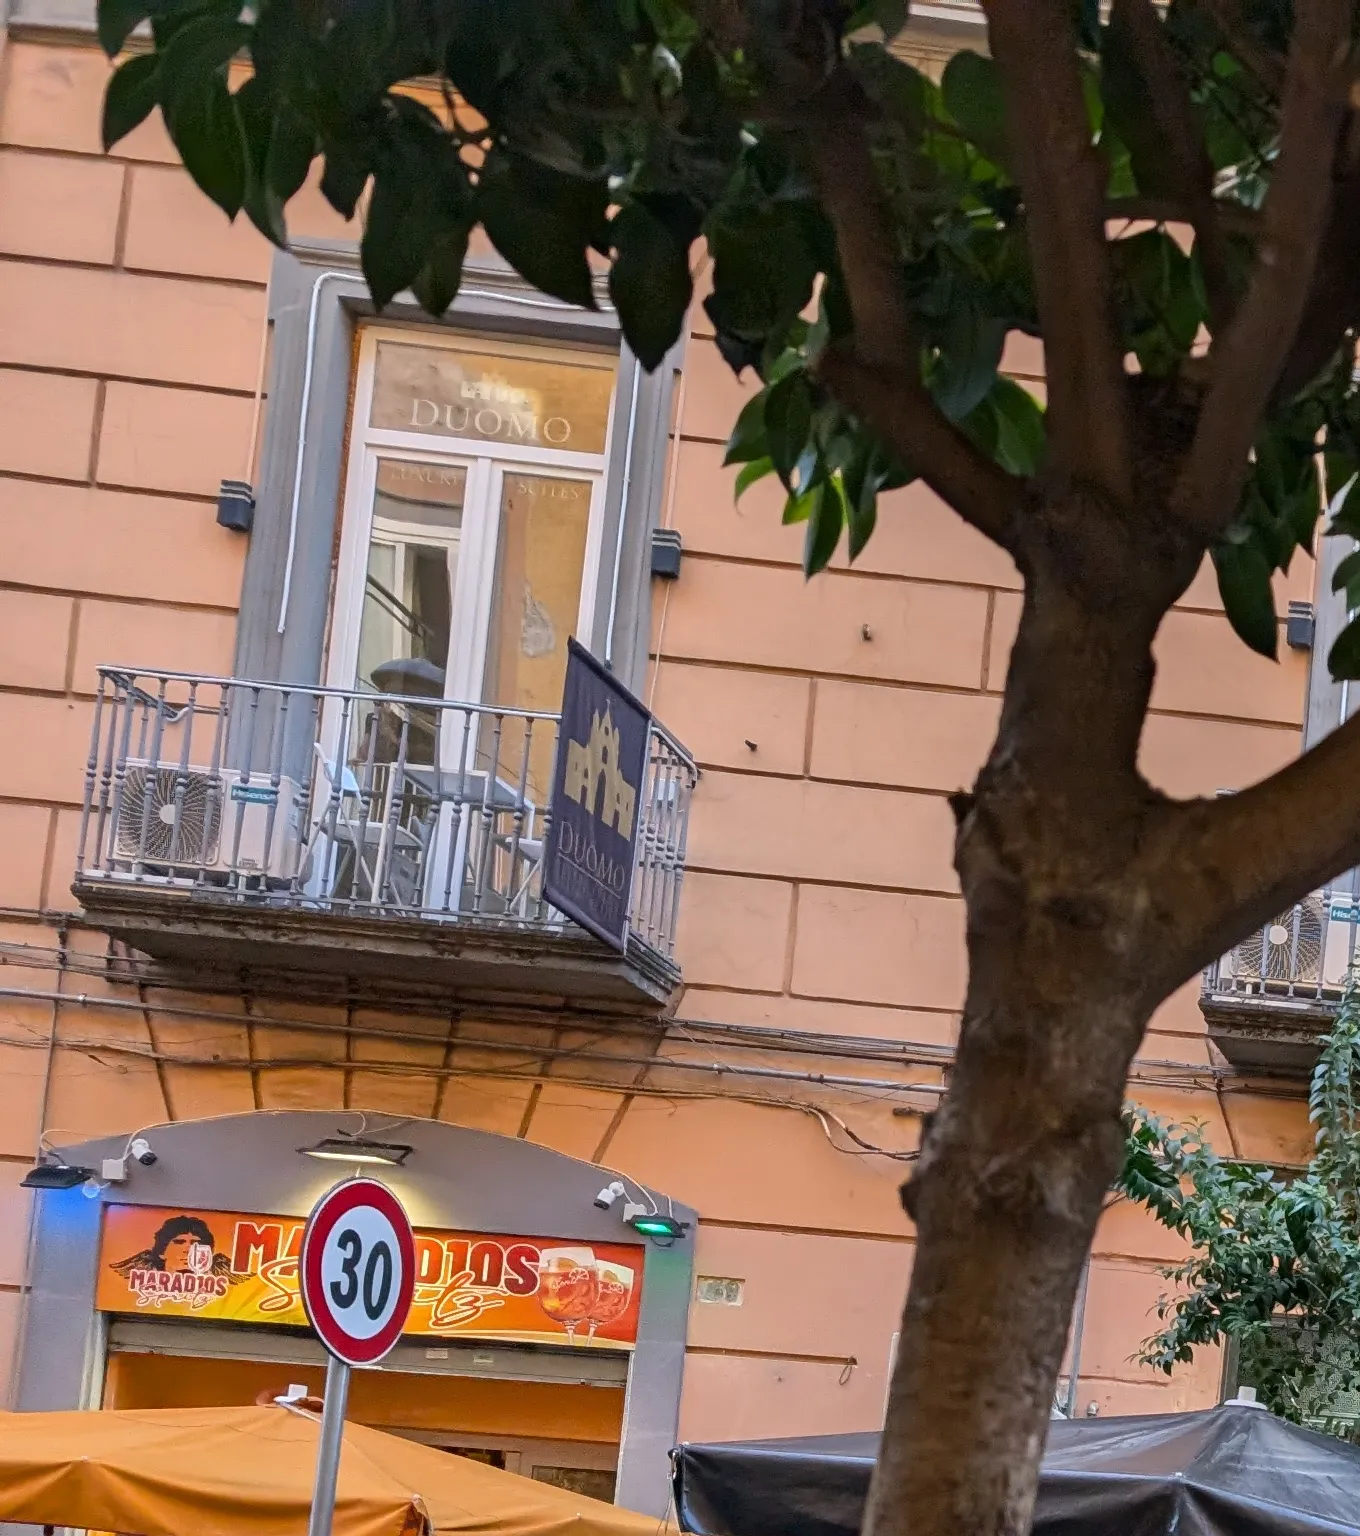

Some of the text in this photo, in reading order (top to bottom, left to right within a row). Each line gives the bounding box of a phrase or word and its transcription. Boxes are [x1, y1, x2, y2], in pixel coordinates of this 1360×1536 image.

[409, 399, 571, 443] DUOMO
[558, 820, 624, 892] DUOMO
[330, 1228, 393, 1321] 30
